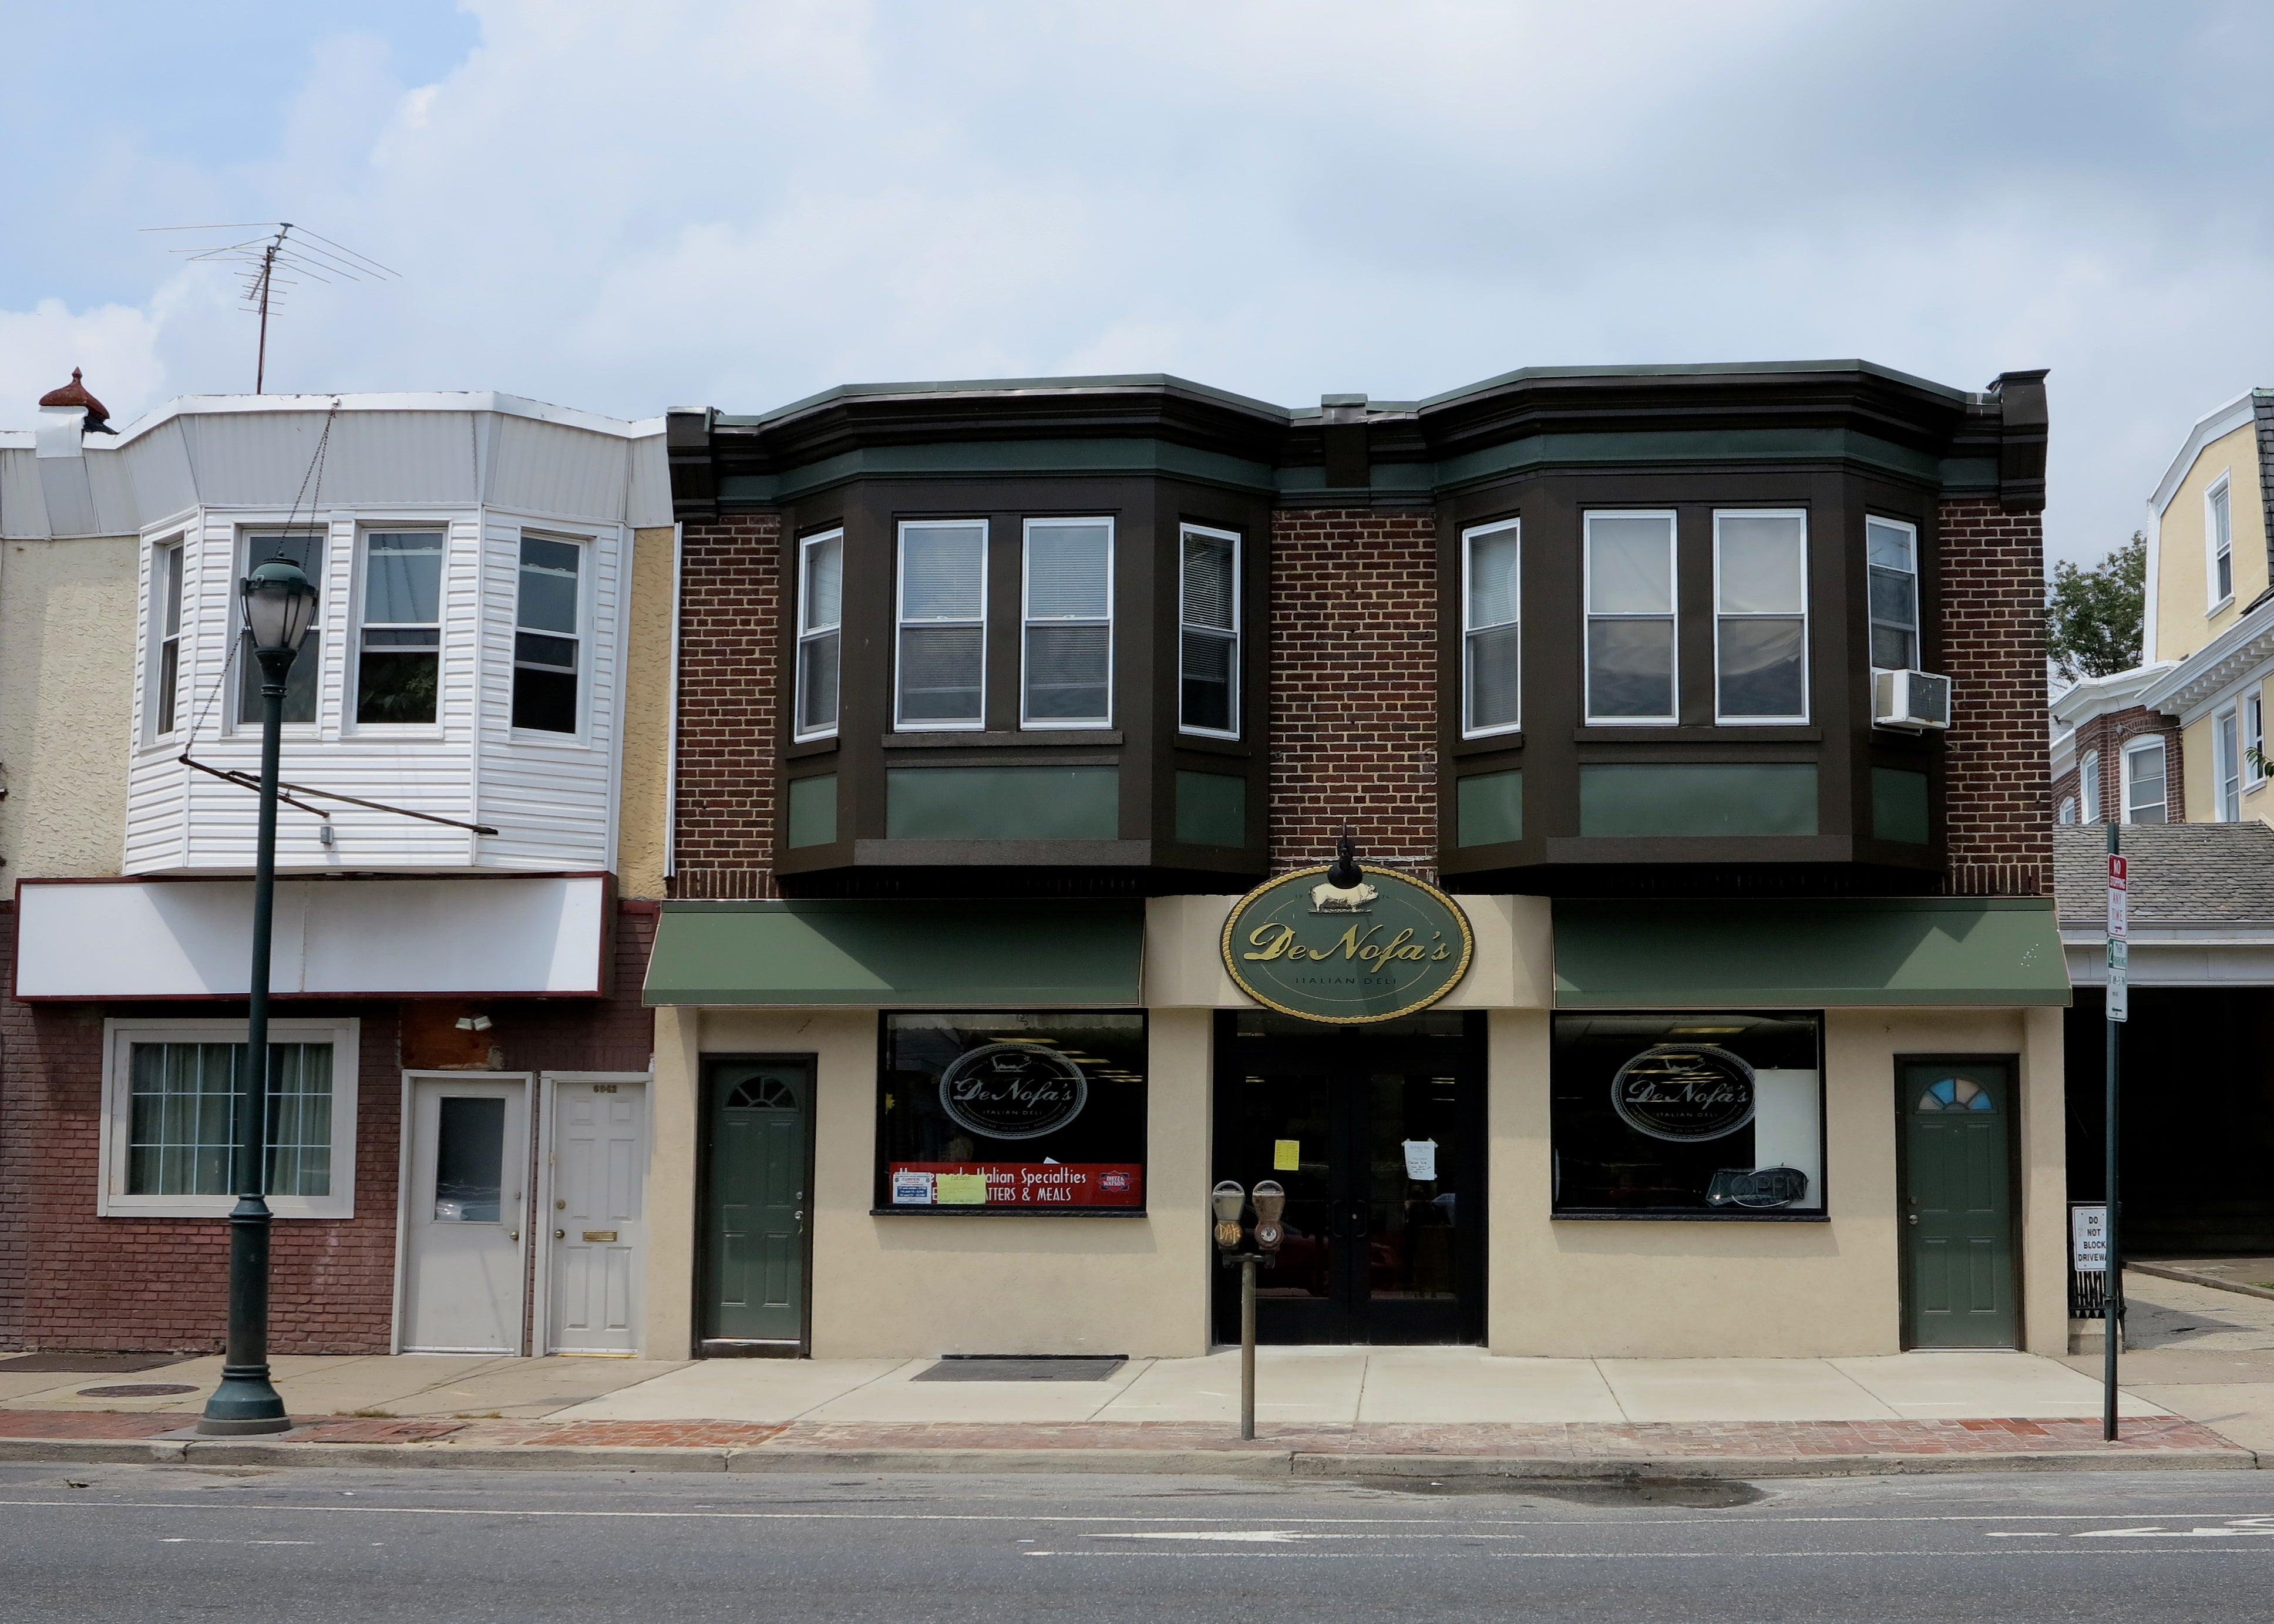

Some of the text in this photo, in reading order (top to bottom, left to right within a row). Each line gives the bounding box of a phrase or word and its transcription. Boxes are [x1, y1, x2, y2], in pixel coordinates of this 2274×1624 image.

[2113, 859, 2121, 875] NO
[2112, 891, 2122, 905] ANY
[2112, 908, 2123, 922] TIME
[1021, 1167, 1086, 1185] Specialties
[1022, 1188, 1031, 1201] &
[1037, 1188, 1071, 1201] MEALS
[1731, 1175, 1807, 1199] OPEN
